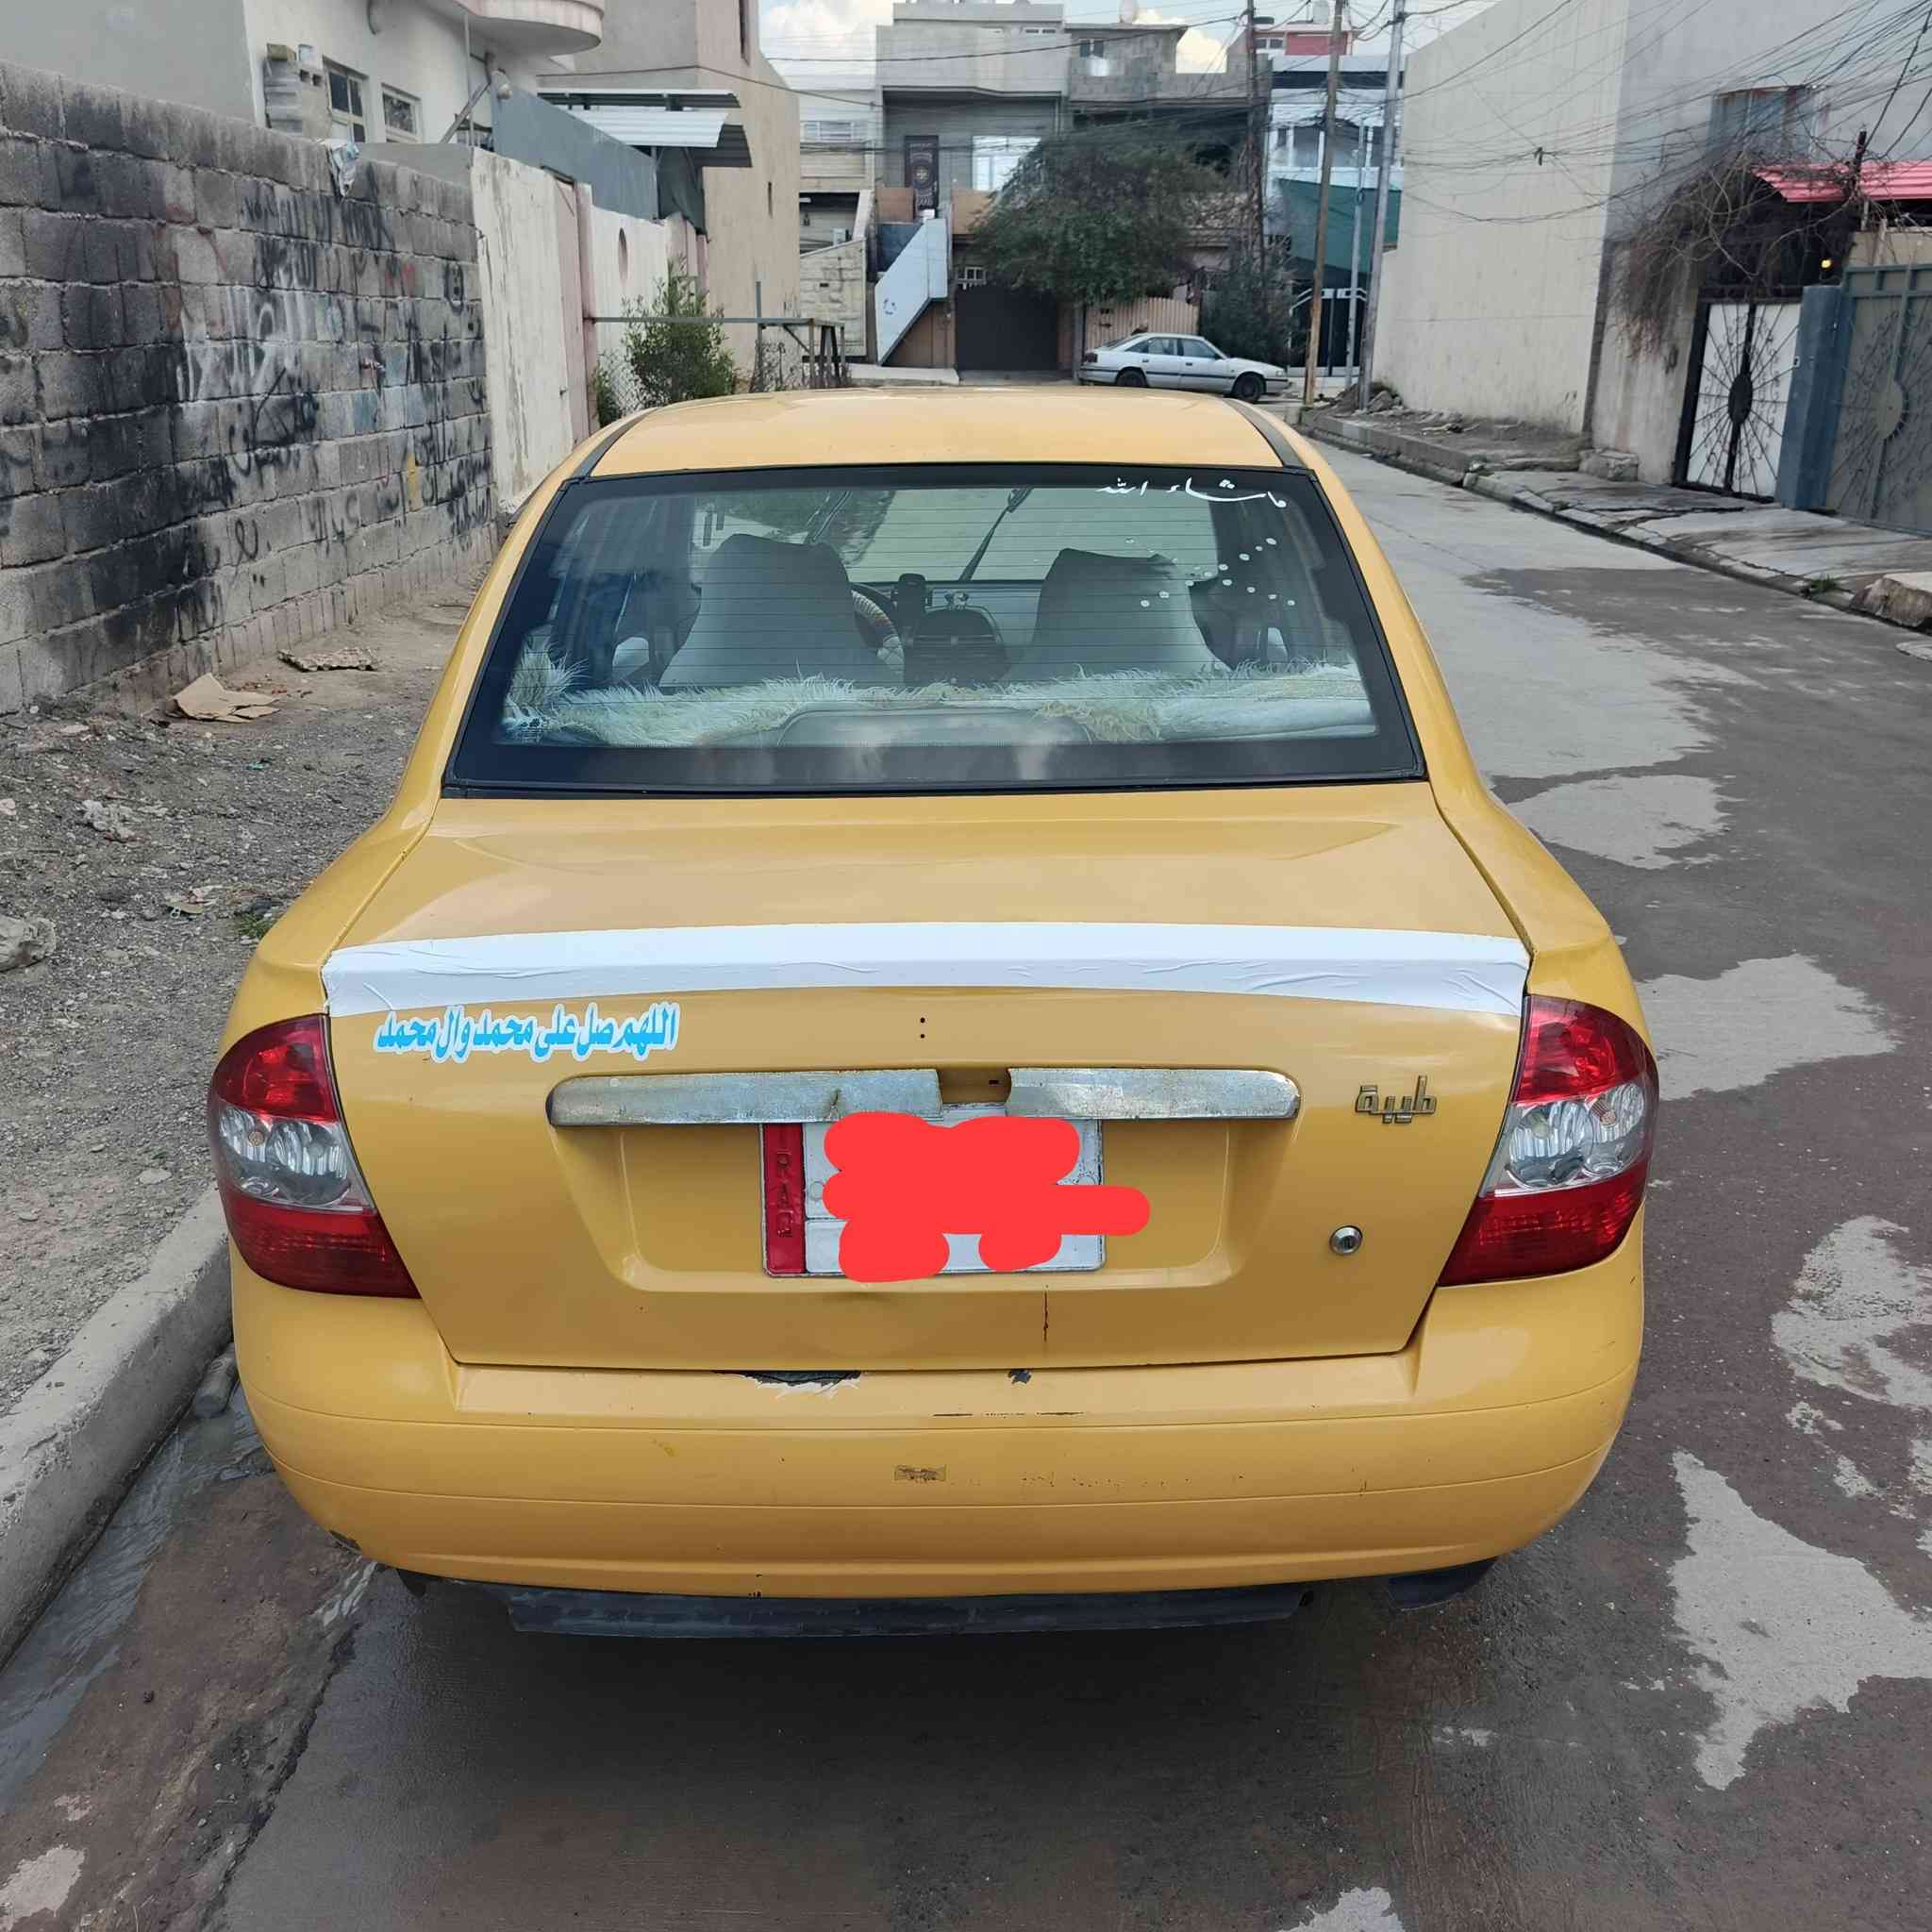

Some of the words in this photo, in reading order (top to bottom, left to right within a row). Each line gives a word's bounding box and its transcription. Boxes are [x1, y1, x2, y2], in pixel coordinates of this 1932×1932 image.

[376, 1012, 439, 1050] محمد
[472, 1011, 535, 1049] محمد
[533, 1006, 578, 1058] على
[575, 1005, 615, 1058] صل
[612, 1004, 678, 1058] اللهم
[1355, 1074, 1437, 1124] طيبة
